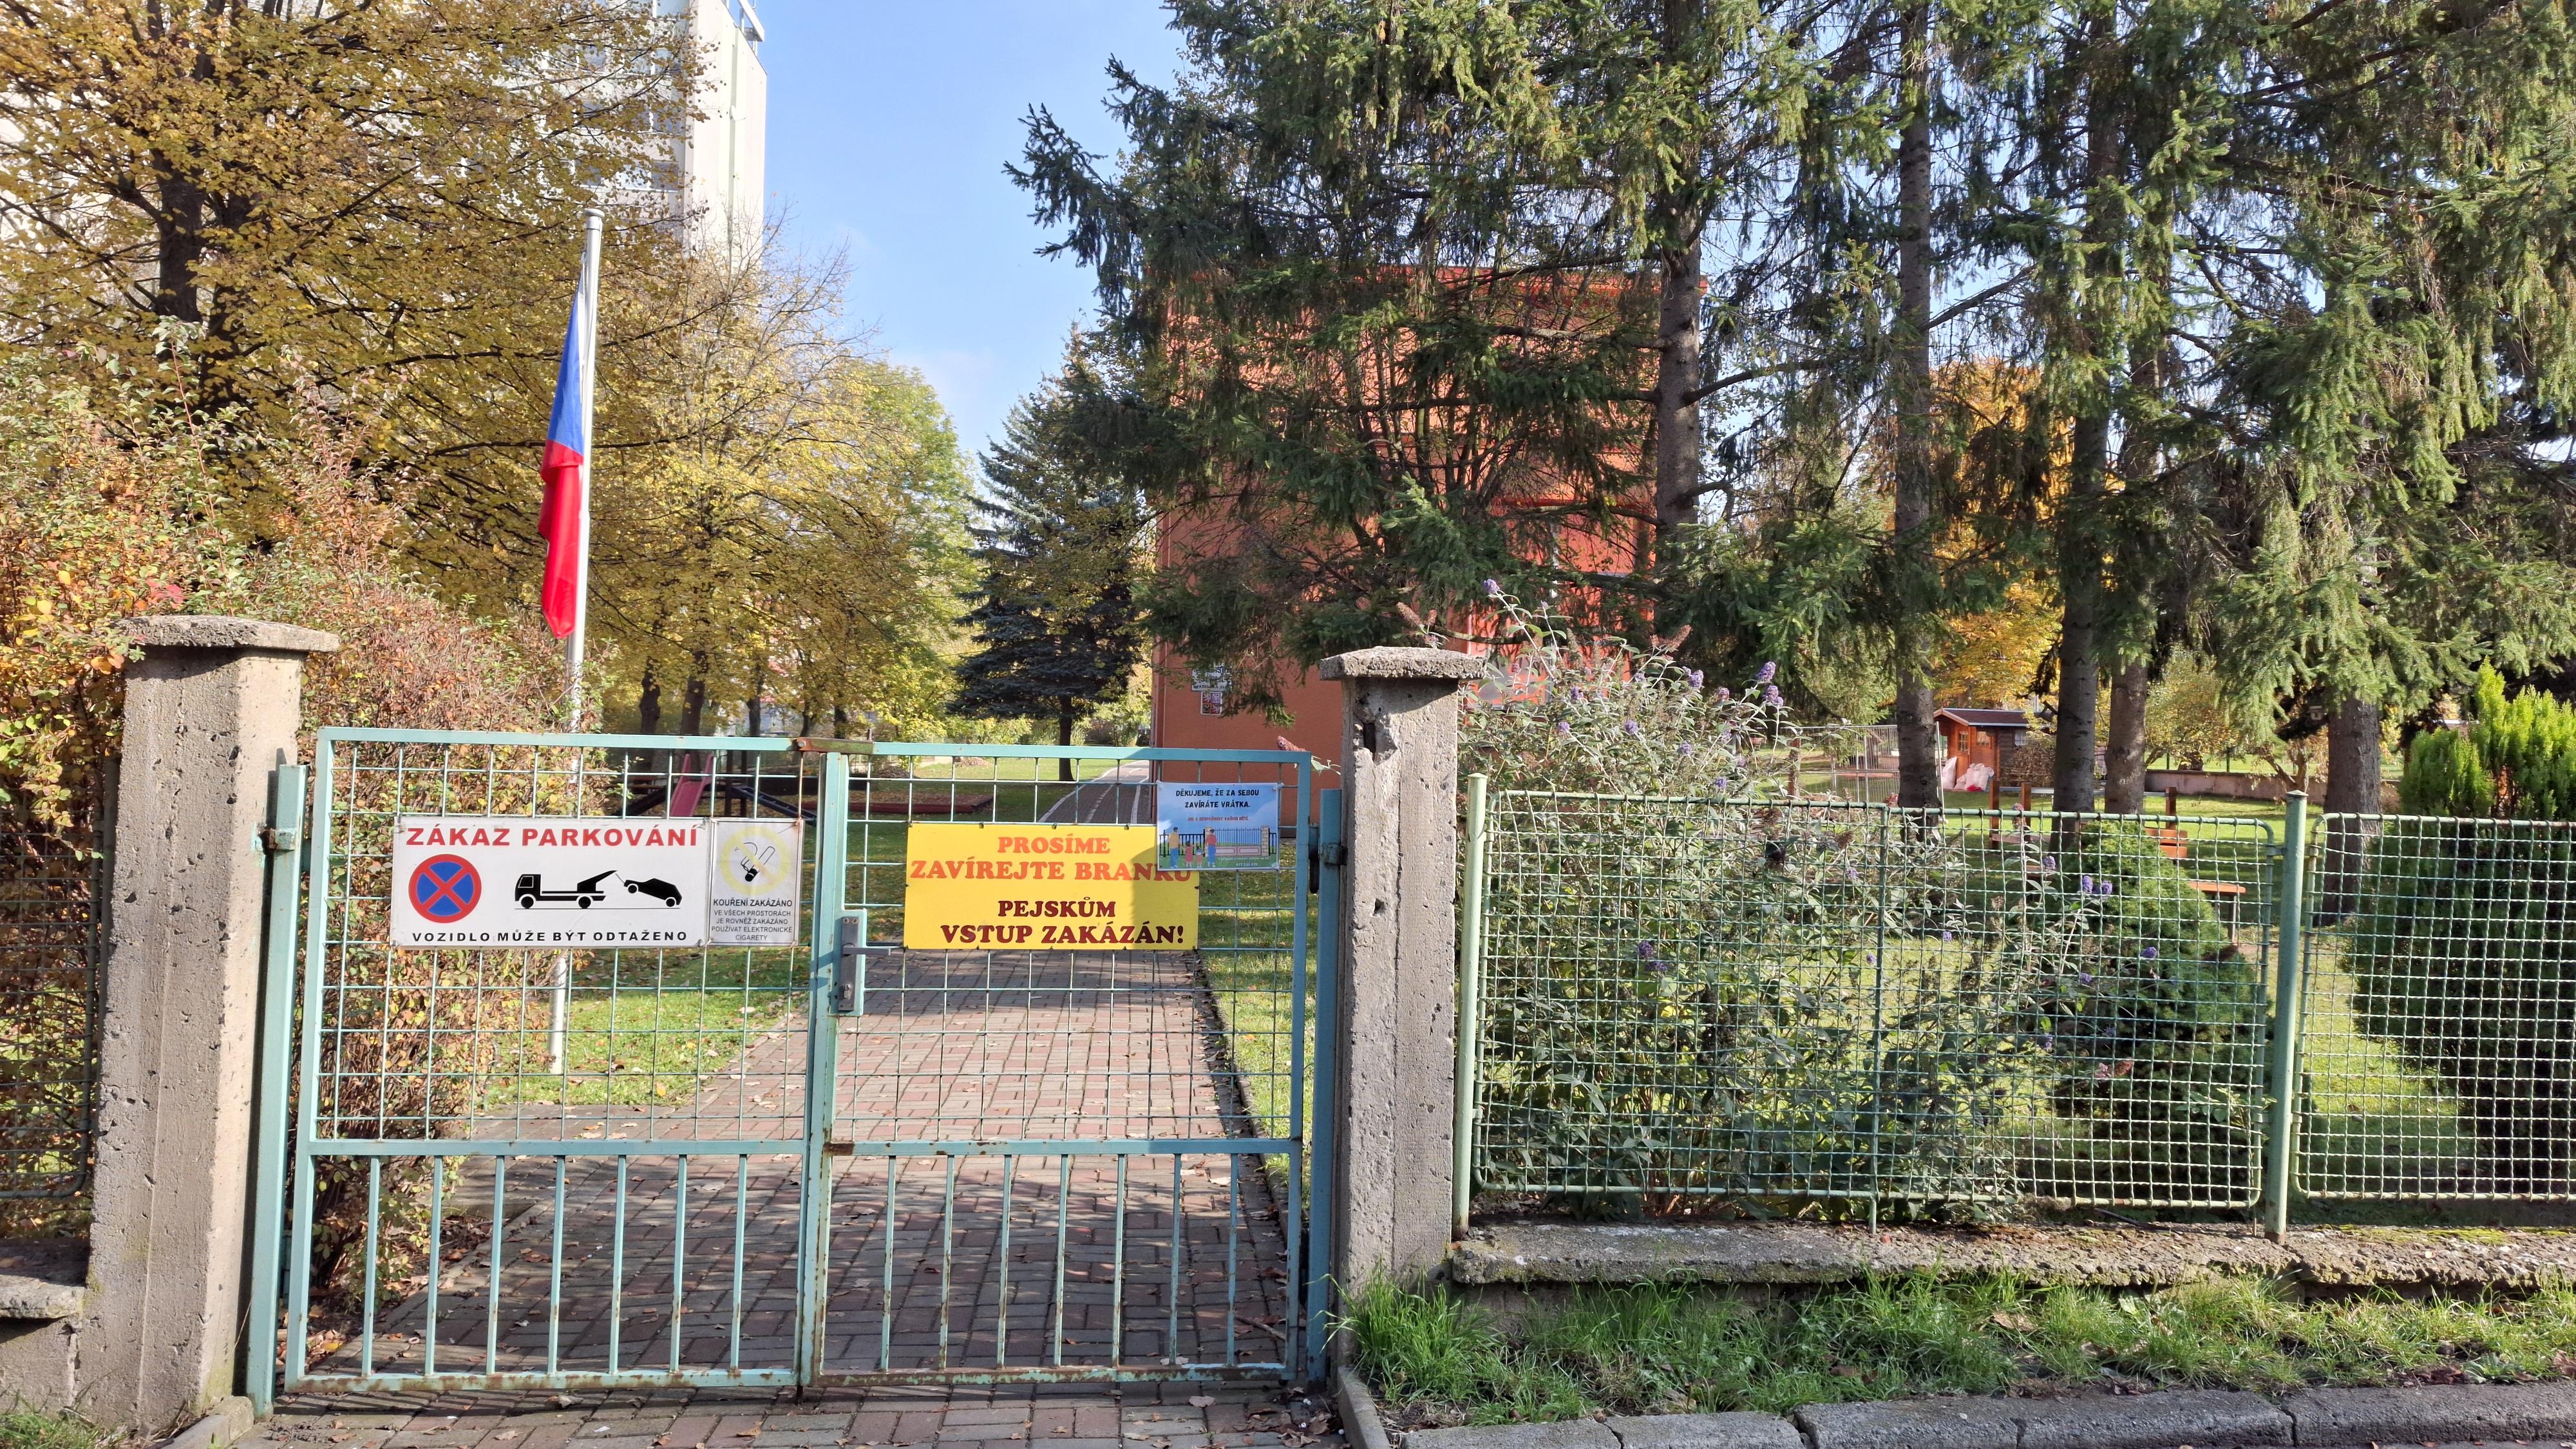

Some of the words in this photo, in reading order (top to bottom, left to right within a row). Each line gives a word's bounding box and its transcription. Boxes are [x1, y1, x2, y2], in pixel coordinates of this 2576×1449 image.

[1176, 788, 1213, 797] DĚKUJEME,
[1185, 799, 1218, 808] ZAVÍRÁTE
[1221, 799, 1251, 808] VRÁTKA.
[407, 824, 510, 846] ZÁKAZ
[522, 825, 697, 847] PARKOVÁNÍ
[998, 833, 1111, 855] PROSÍME
[911, 855, 1065, 880] ZAVÍREJTE
[713, 897, 748, 906] KOUŘENÍ
[750, 898, 793, 907] ZAKÁZÁNO
[998, 896, 1117, 918] PEJSKŮM
[412, 932, 490, 942] VOZIDLO
[497, 929, 545, 942] MŮŽE
[553, 930, 586, 942] BÝT
[592, 930, 687, 942] ODTAŽENO
[940, 925, 1032, 944] VSTUP
[1041, 921, 1184, 944] ZAKÁZÁN!
